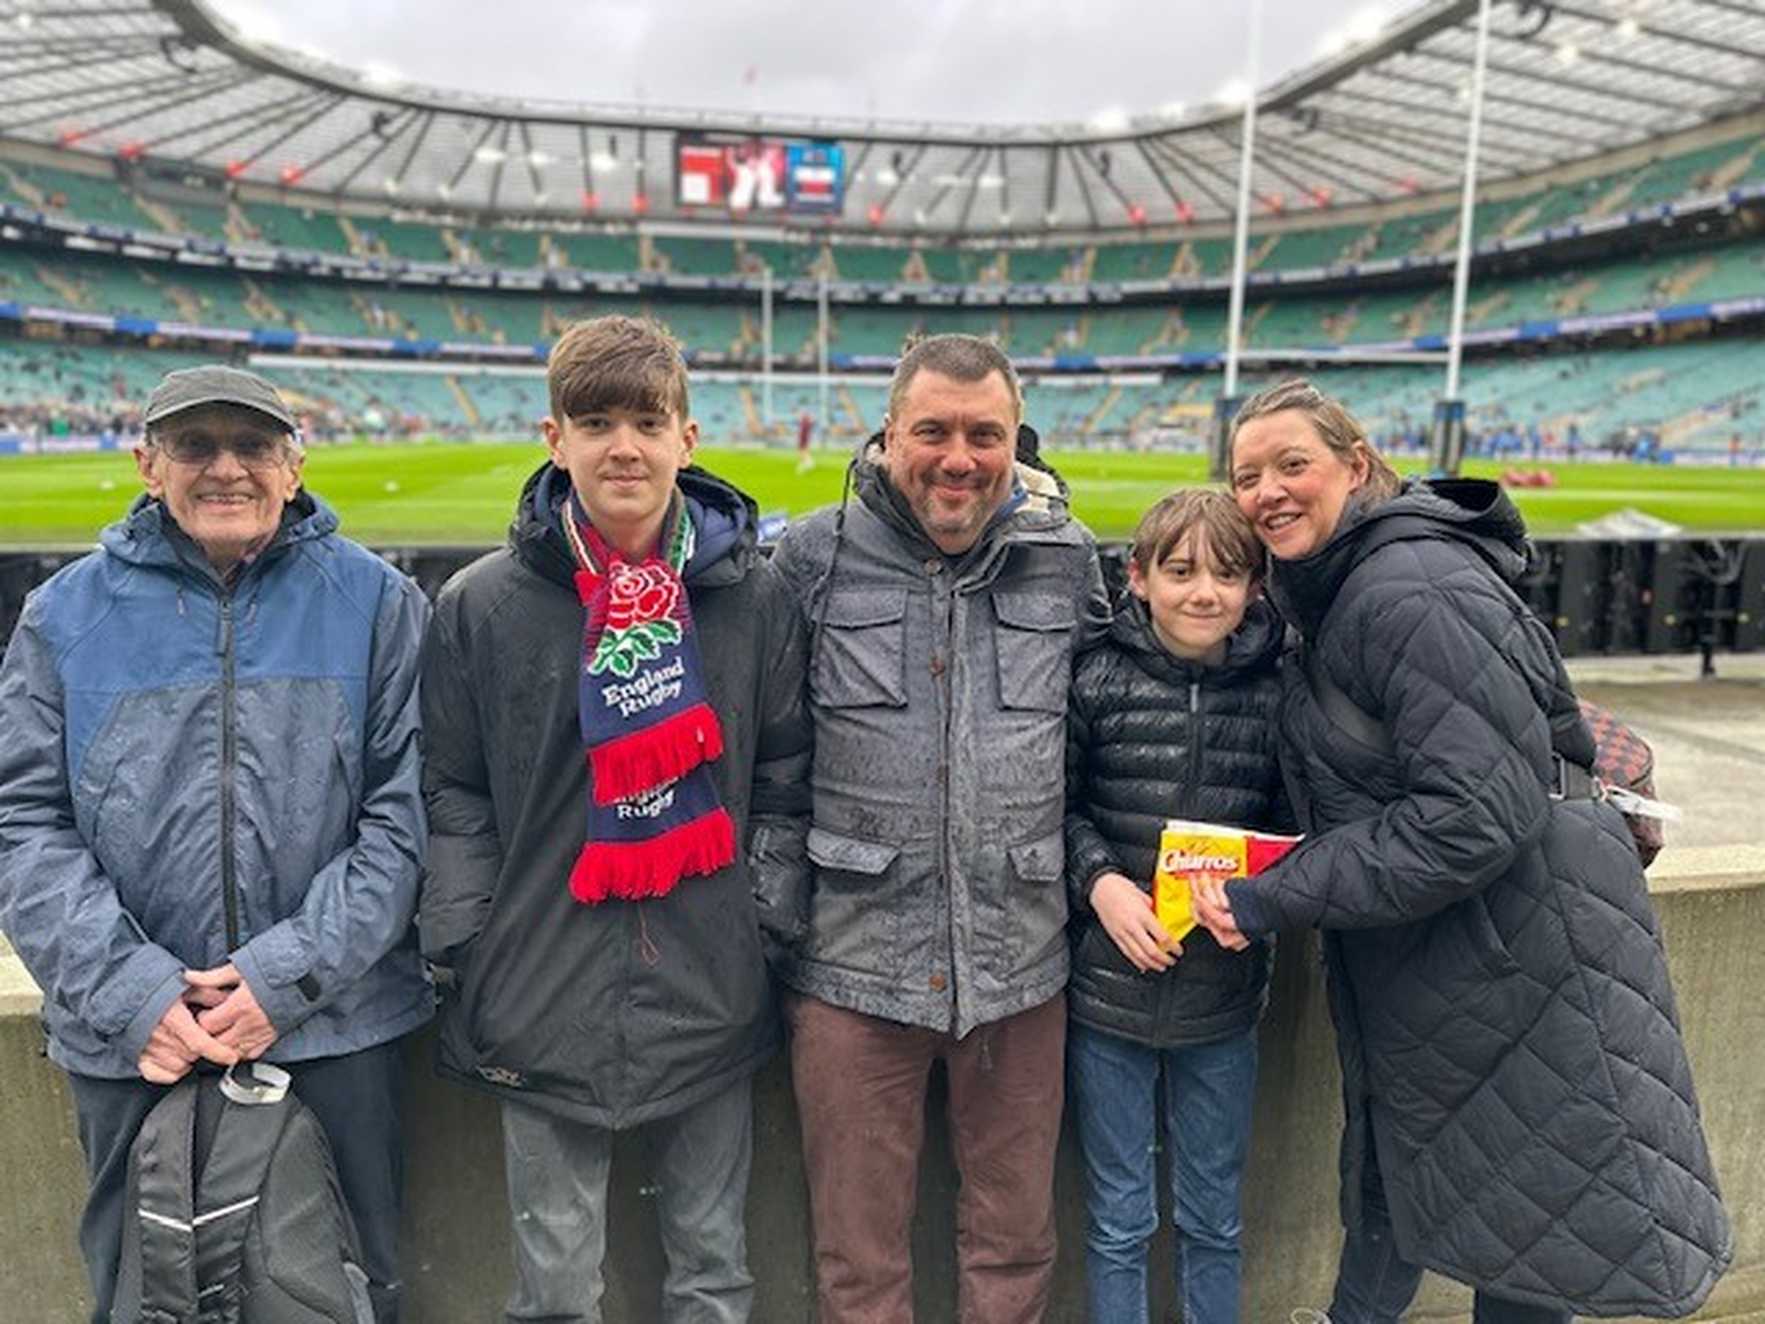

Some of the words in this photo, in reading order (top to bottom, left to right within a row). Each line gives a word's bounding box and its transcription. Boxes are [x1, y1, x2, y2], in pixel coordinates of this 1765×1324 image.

[602, 656, 685, 706] England
[619, 680, 682, 718] Rugby
[617, 789, 675, 819] Rugby
